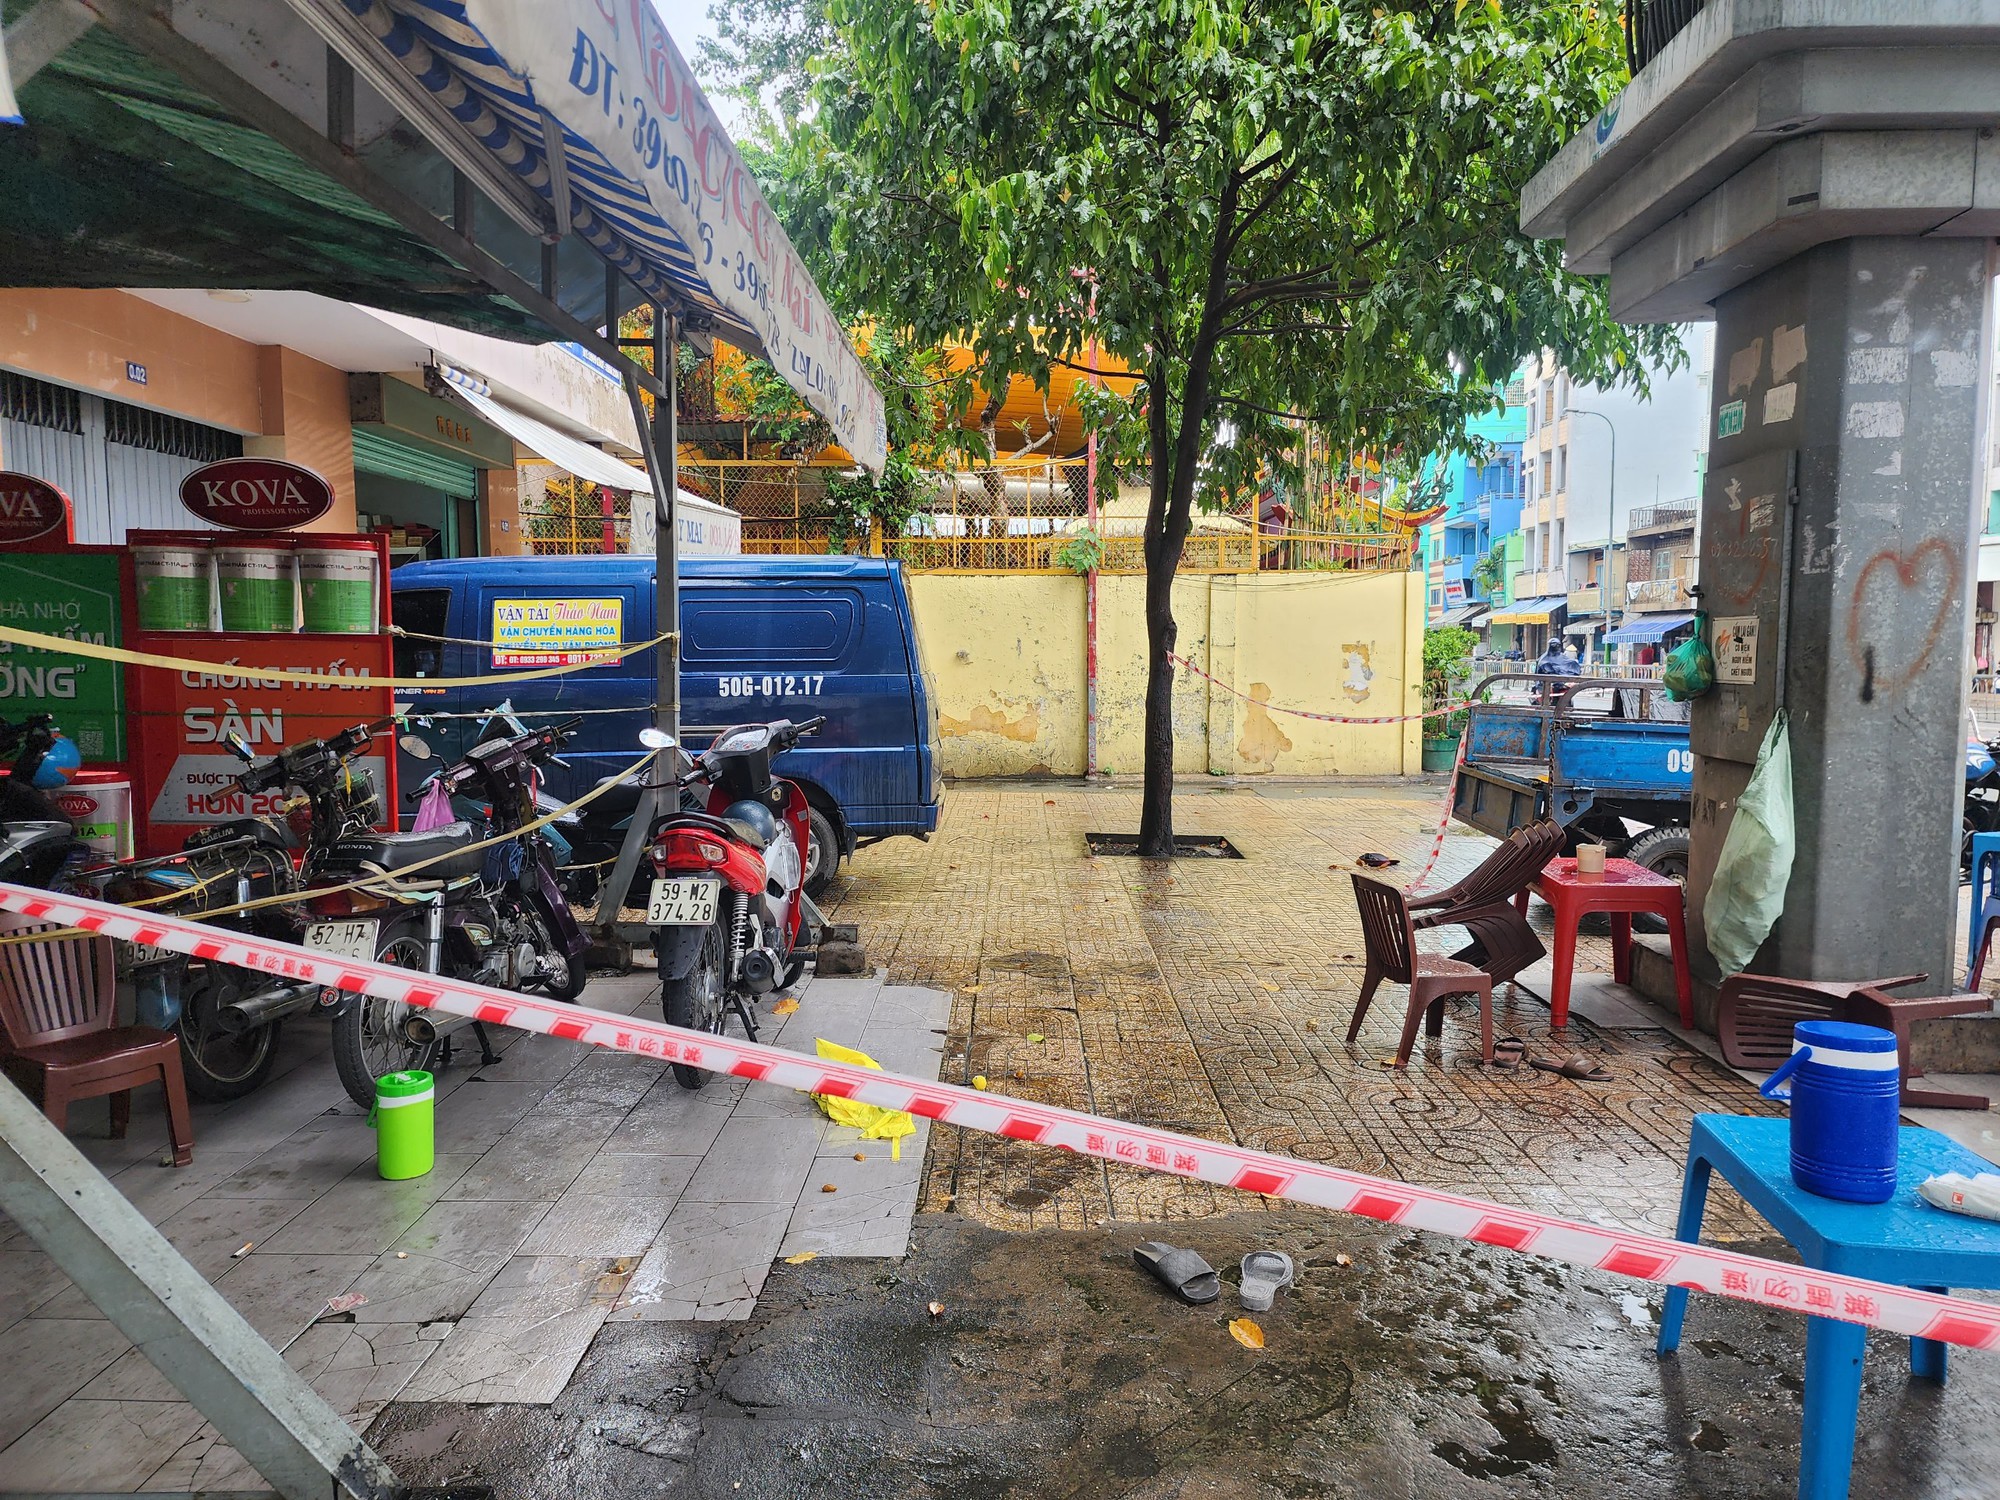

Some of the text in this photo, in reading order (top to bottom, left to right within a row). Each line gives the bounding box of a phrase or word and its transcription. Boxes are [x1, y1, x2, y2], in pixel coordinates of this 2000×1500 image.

[200, 479, 309, 507] KOVA
[498, 601, 618, 623] VẬN TẢI Thảo Nam
[500, 623, 616, 639] VẬN CHUYỂN HÀNG HÓA
[719, 676, 824, 697] 50G-012.17
[184, 699, 284, 743] SÀN
[1667, 749, 1694, 773] 09
[187, 773, 223, 786] ĐƯỢC
[200, 827, 235, 845] DAELIM
[661, 883, 710, 901] 59-M2
[651, 903, 712, 921] 374.28
